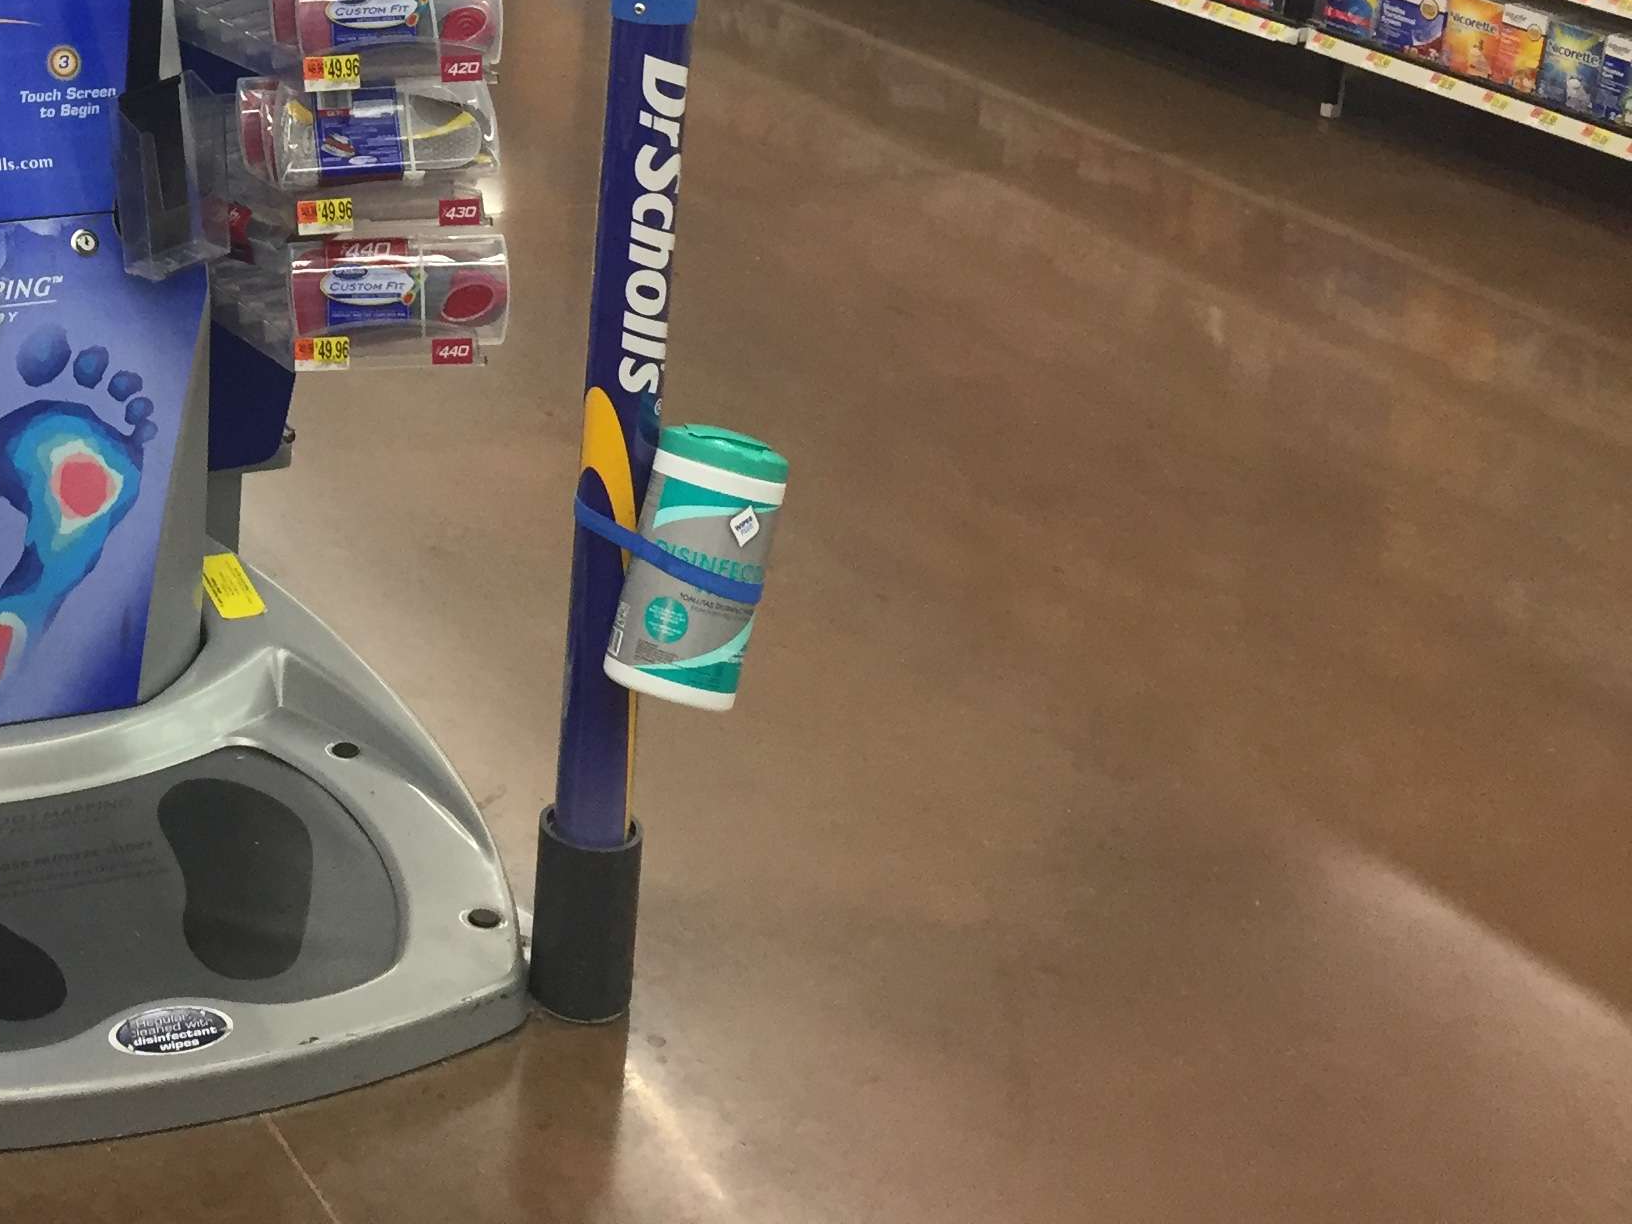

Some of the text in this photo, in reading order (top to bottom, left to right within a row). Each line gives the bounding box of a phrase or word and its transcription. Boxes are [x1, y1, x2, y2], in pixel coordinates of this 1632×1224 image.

[58, 55, 69, 69] 3
[448, 61, 480, 75] 420
[20, 86, 117, 103] Touch Screen
[40, 103, 100, 119] to Begin
[618, 54, 688, 395] Dr.Scholls
[330, 280, 406, 292] CUSTOM FIT
[133, 1026, 217, 1046] disinfectant
[160, 1039, 199, 1051] wipes
